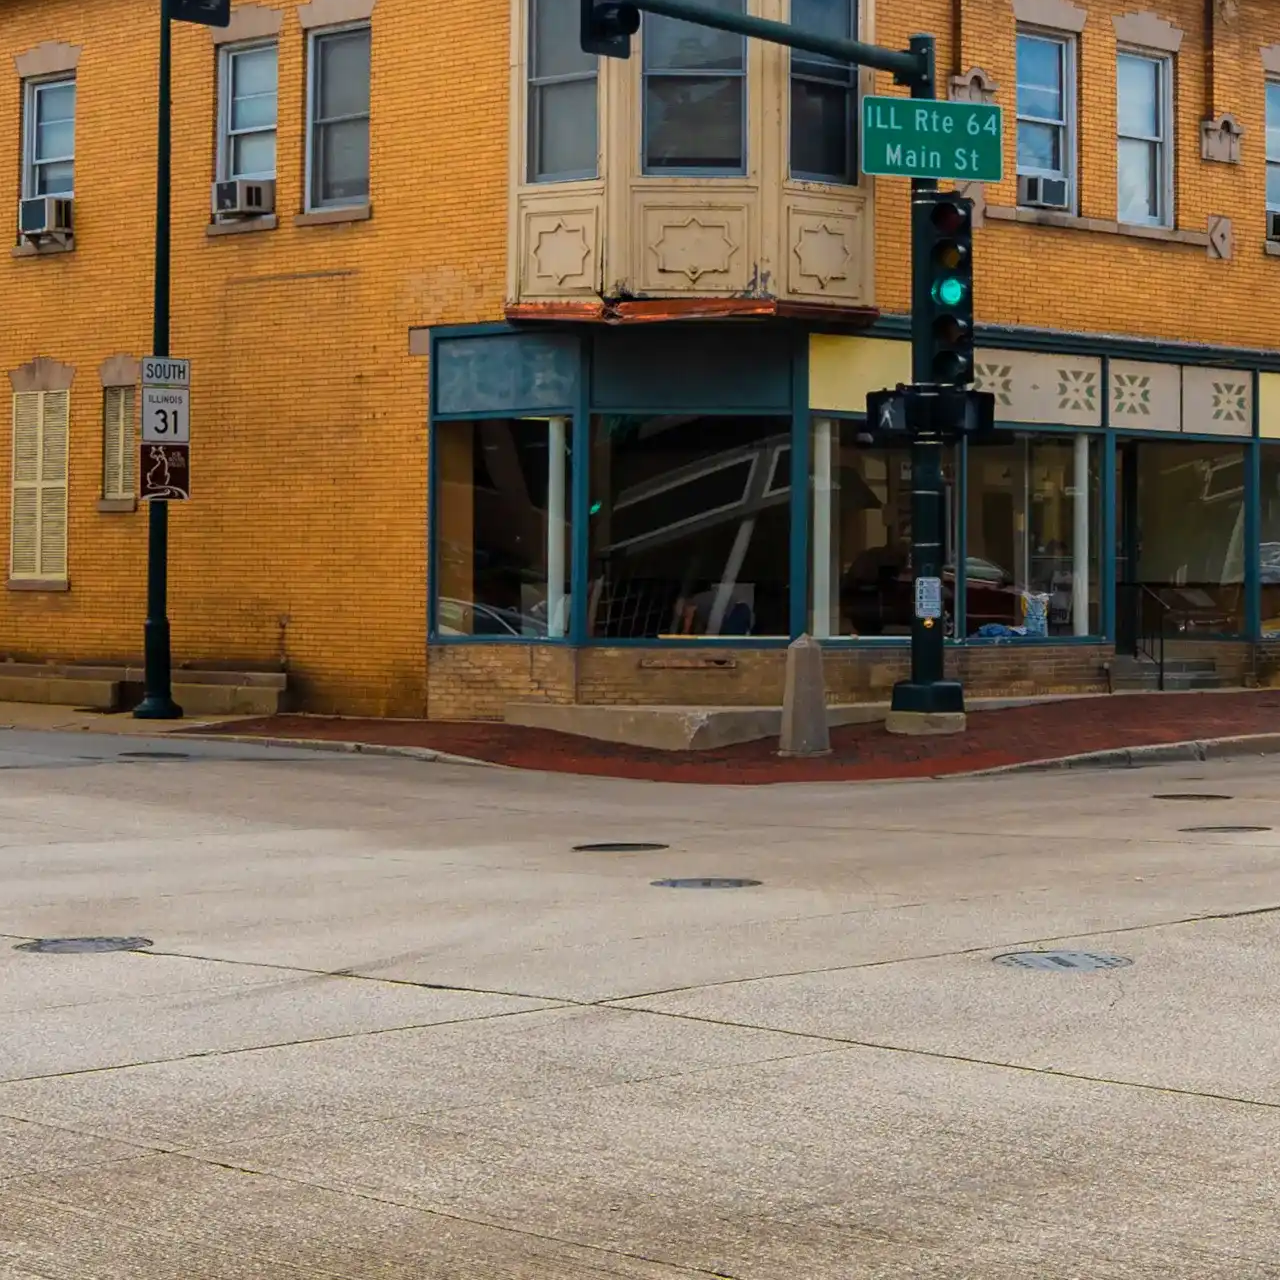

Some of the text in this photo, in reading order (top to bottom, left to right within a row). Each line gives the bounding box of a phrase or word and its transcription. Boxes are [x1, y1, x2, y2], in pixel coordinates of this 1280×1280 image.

[867, 105, 997, 136] ILL Rte 64
[885, 143, 979, 171] Main St
[146, 363, 187, 380] SOUTH
[148, 394, 183, 405] ILLINOIS
[154, 409, 179, 435] 31
